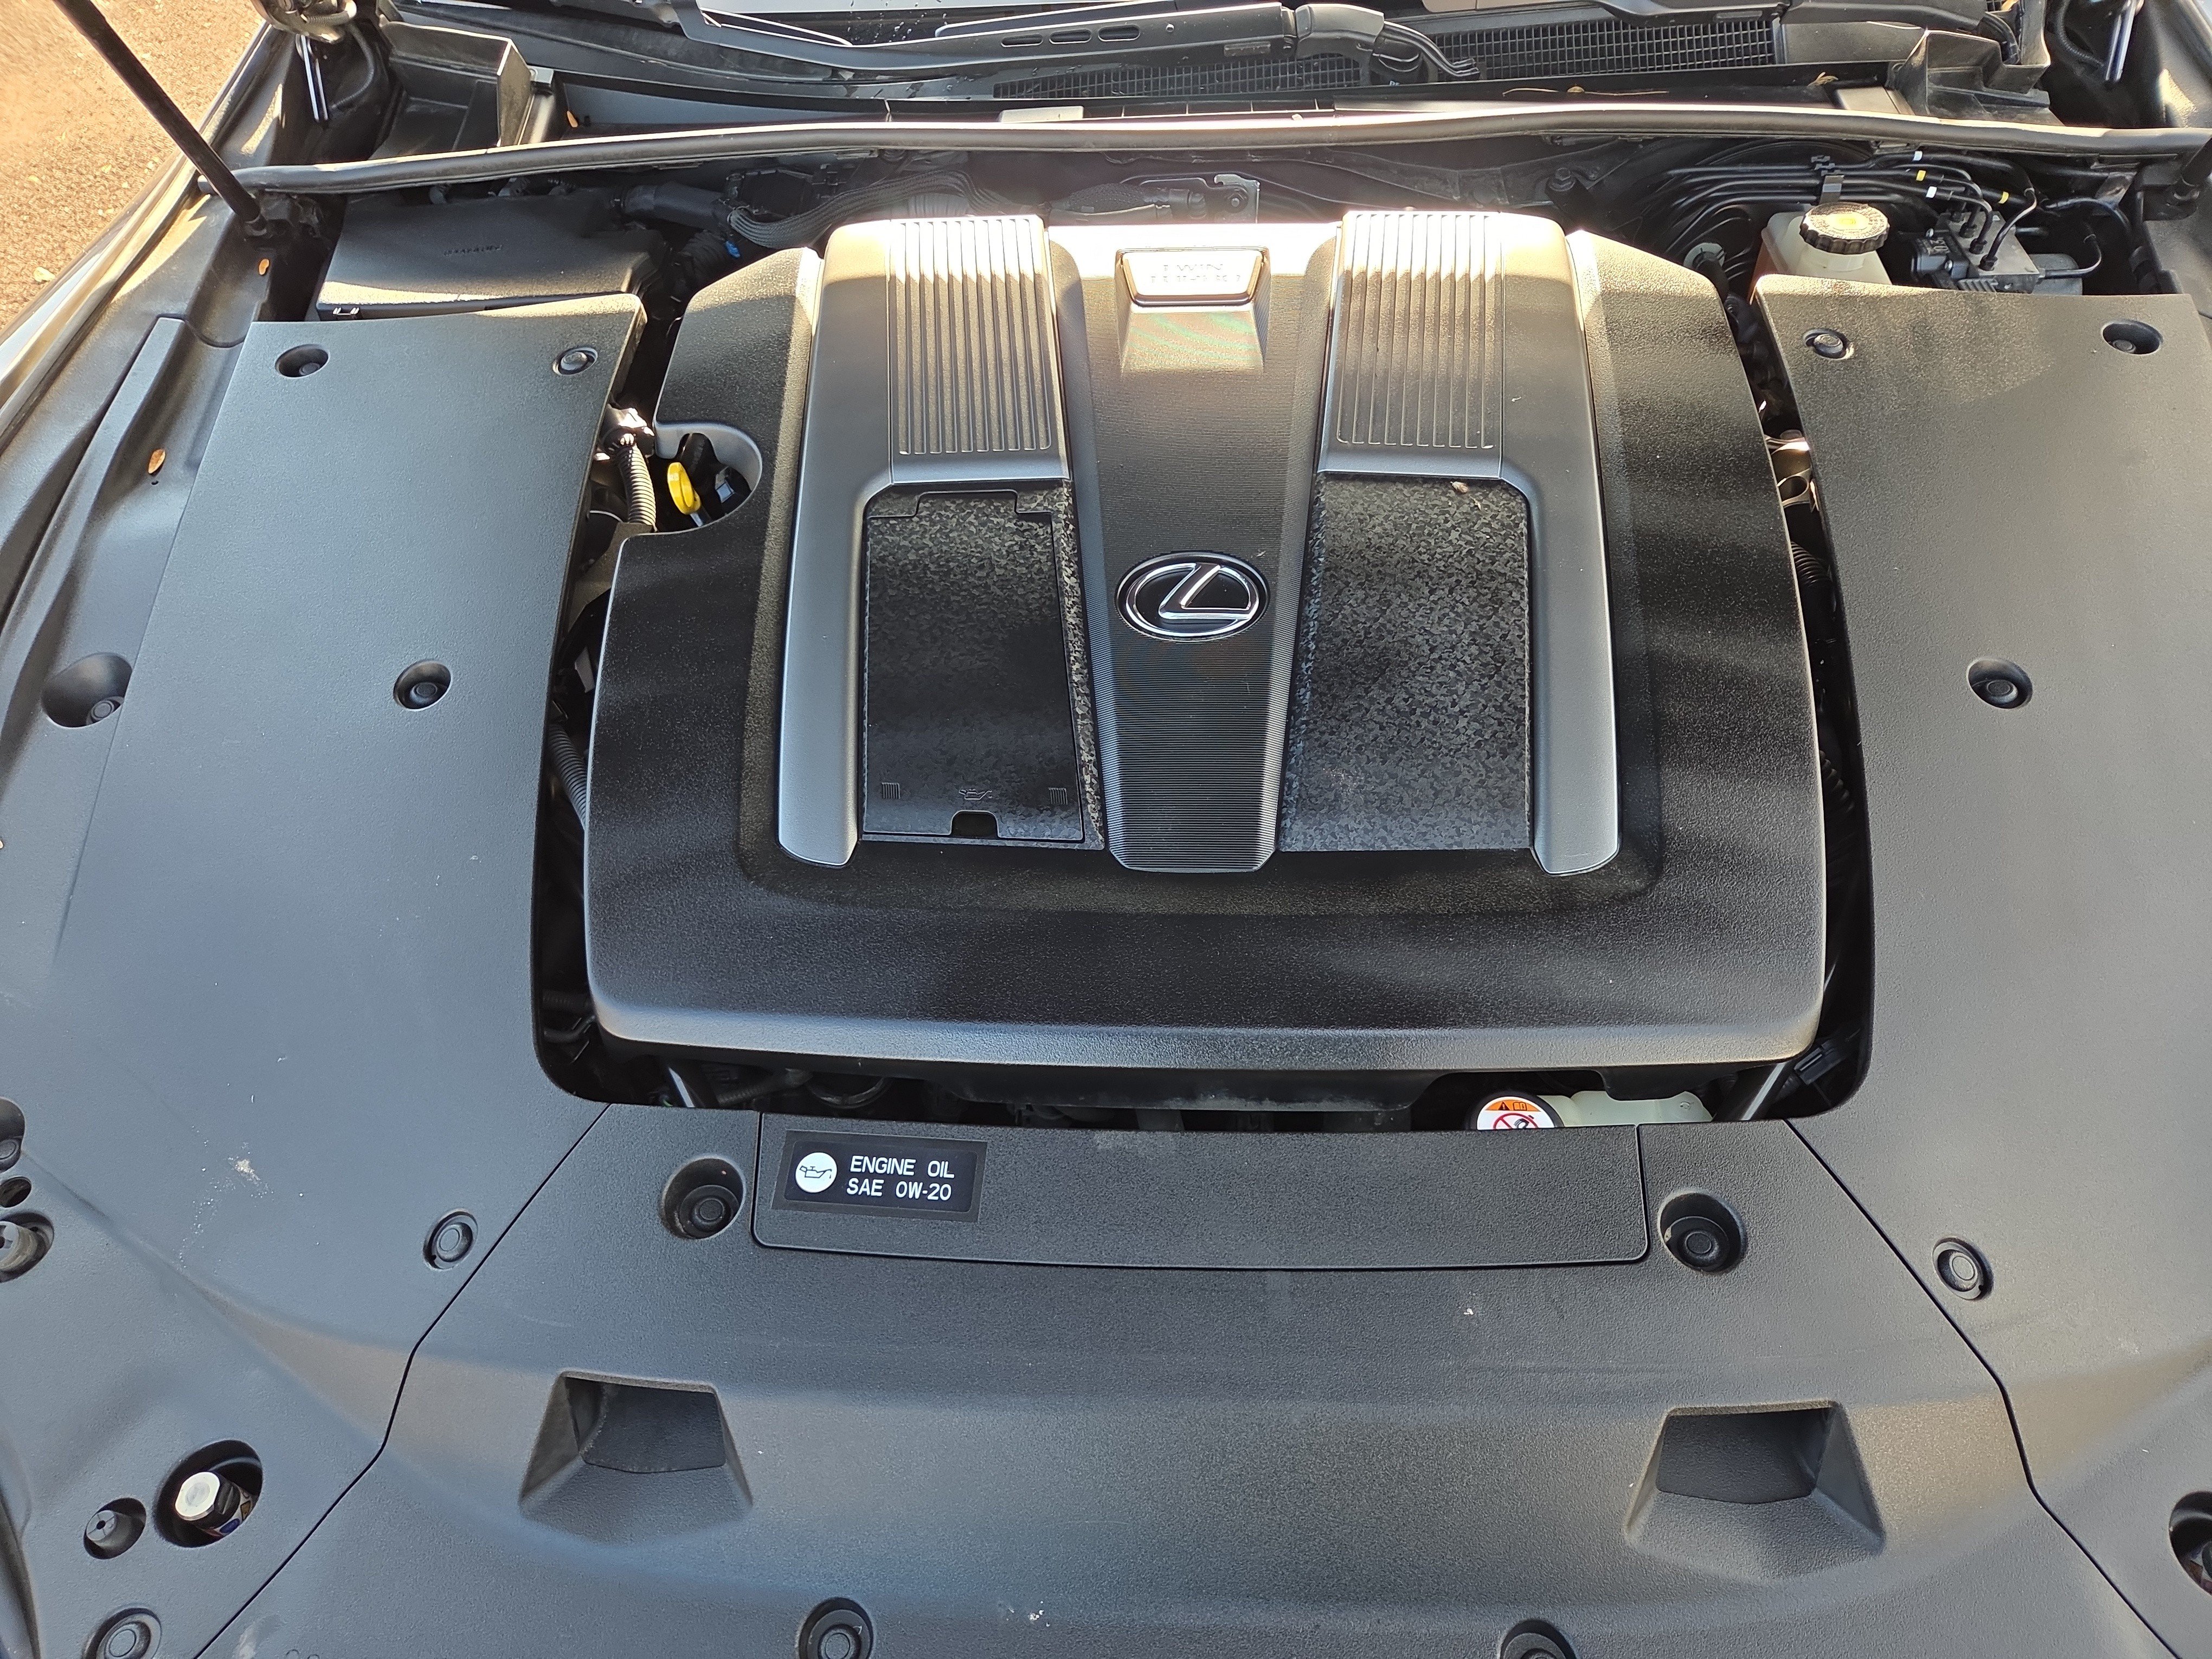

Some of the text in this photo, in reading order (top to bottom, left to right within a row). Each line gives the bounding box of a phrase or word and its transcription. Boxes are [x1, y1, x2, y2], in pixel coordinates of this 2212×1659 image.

[850, 1155, 955, 1179] ENGINE OIL
[846, 1178, 952, 1201] SAE 0W-20
